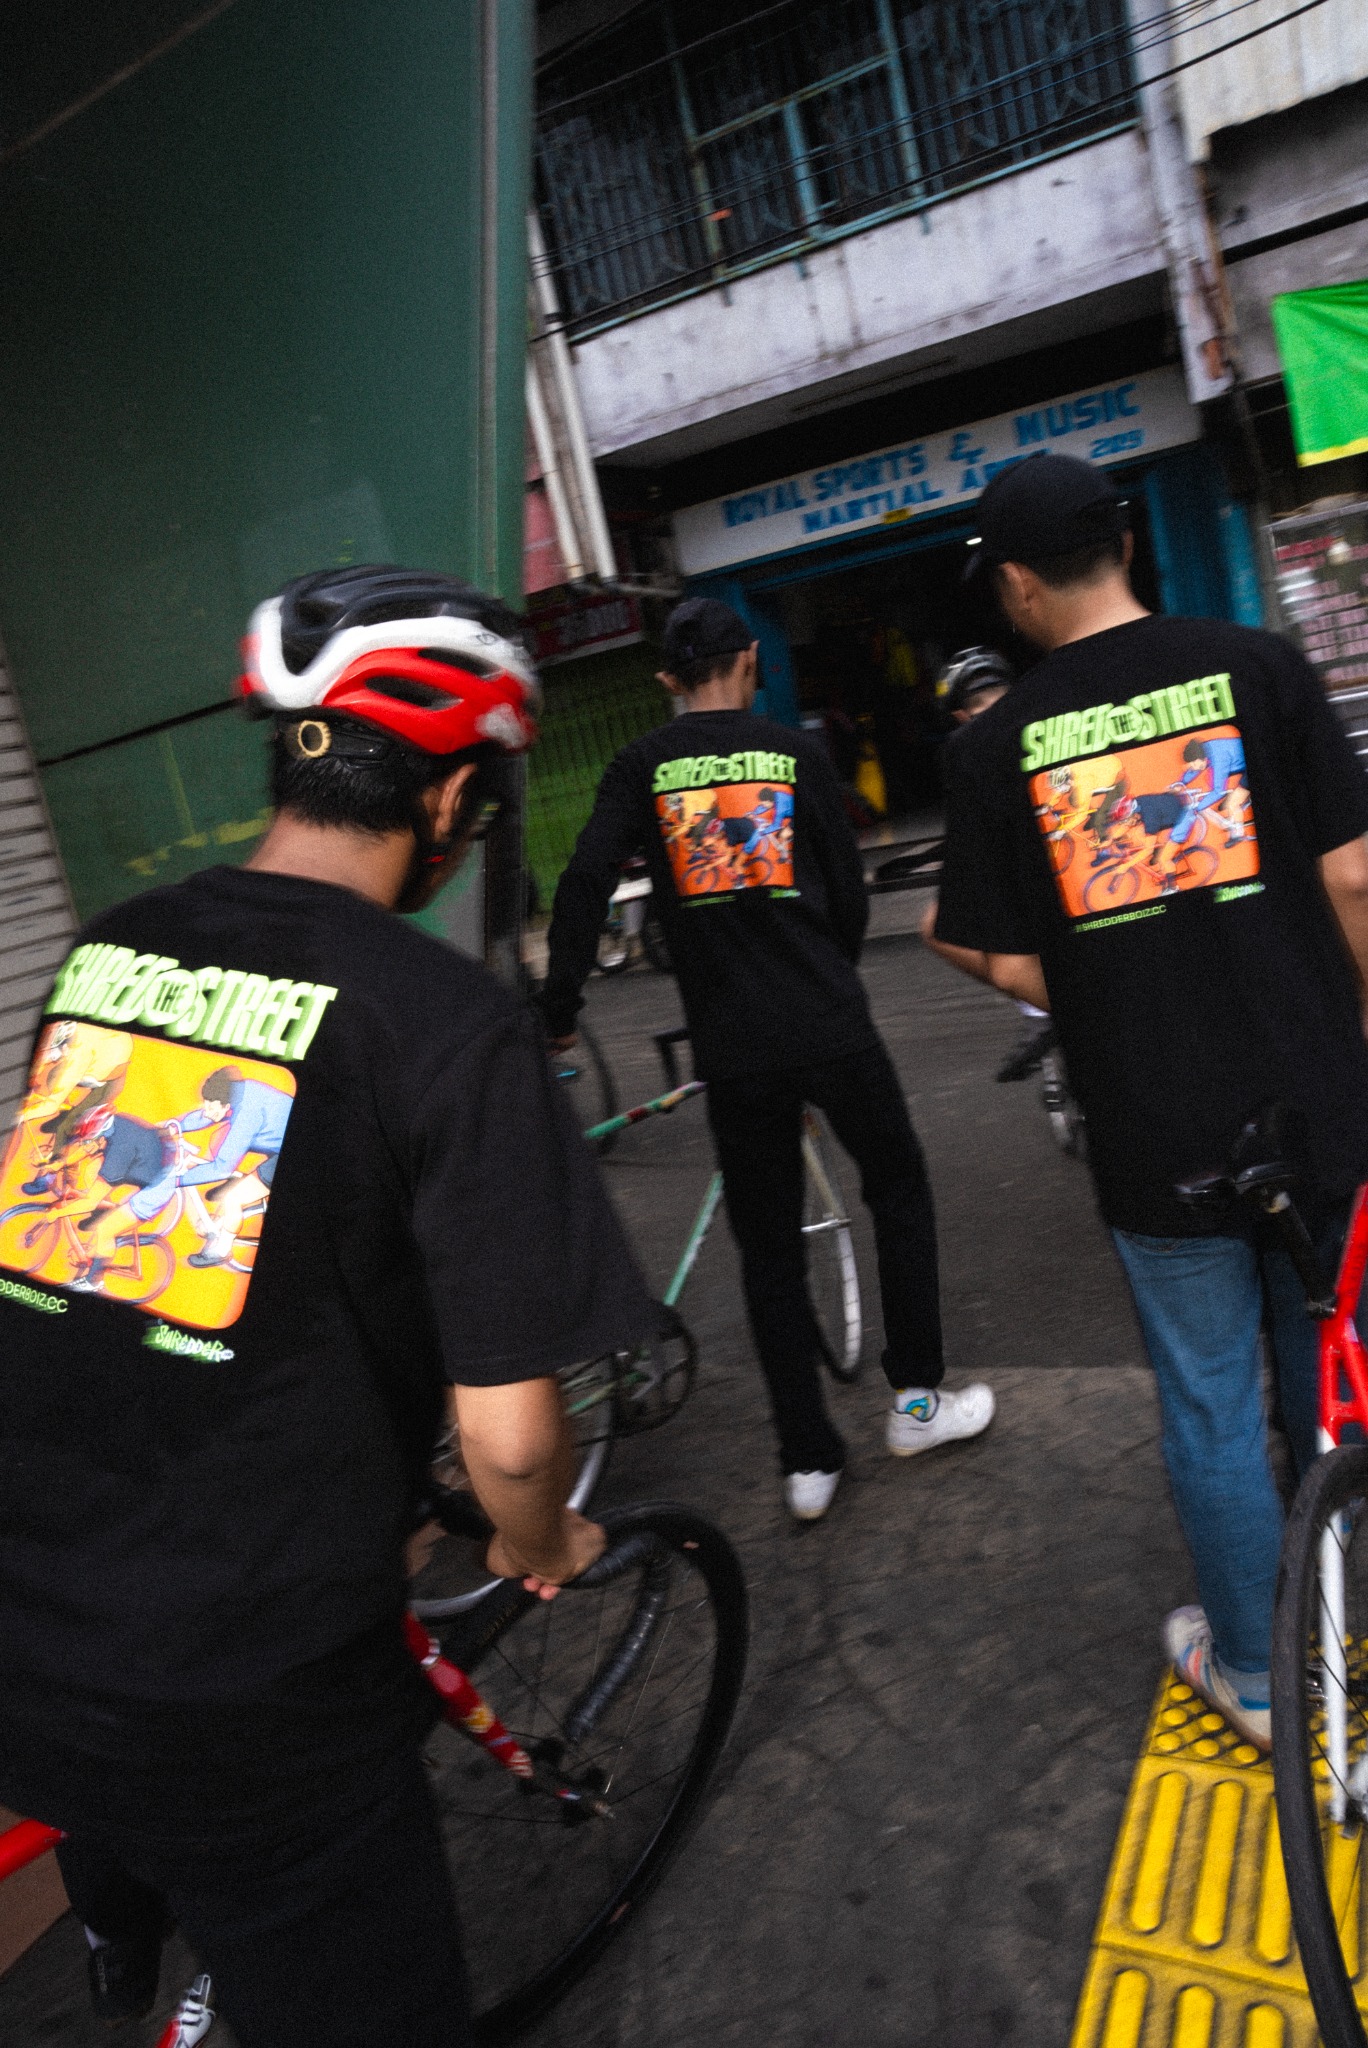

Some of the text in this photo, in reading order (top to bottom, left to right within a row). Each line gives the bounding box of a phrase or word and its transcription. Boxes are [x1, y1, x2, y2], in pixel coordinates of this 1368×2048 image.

[813, 444, 928, 501] SPORTS
[1014, 382, 1141, 447] MUSIC
[802, 480, 944, 534] MARTIAL
[729, 751, 797, 784] STREET
[1020, 672, 1236, 773] SHRED THE STREET
[44, 943, 338, 1061] SHRED THE STREET
